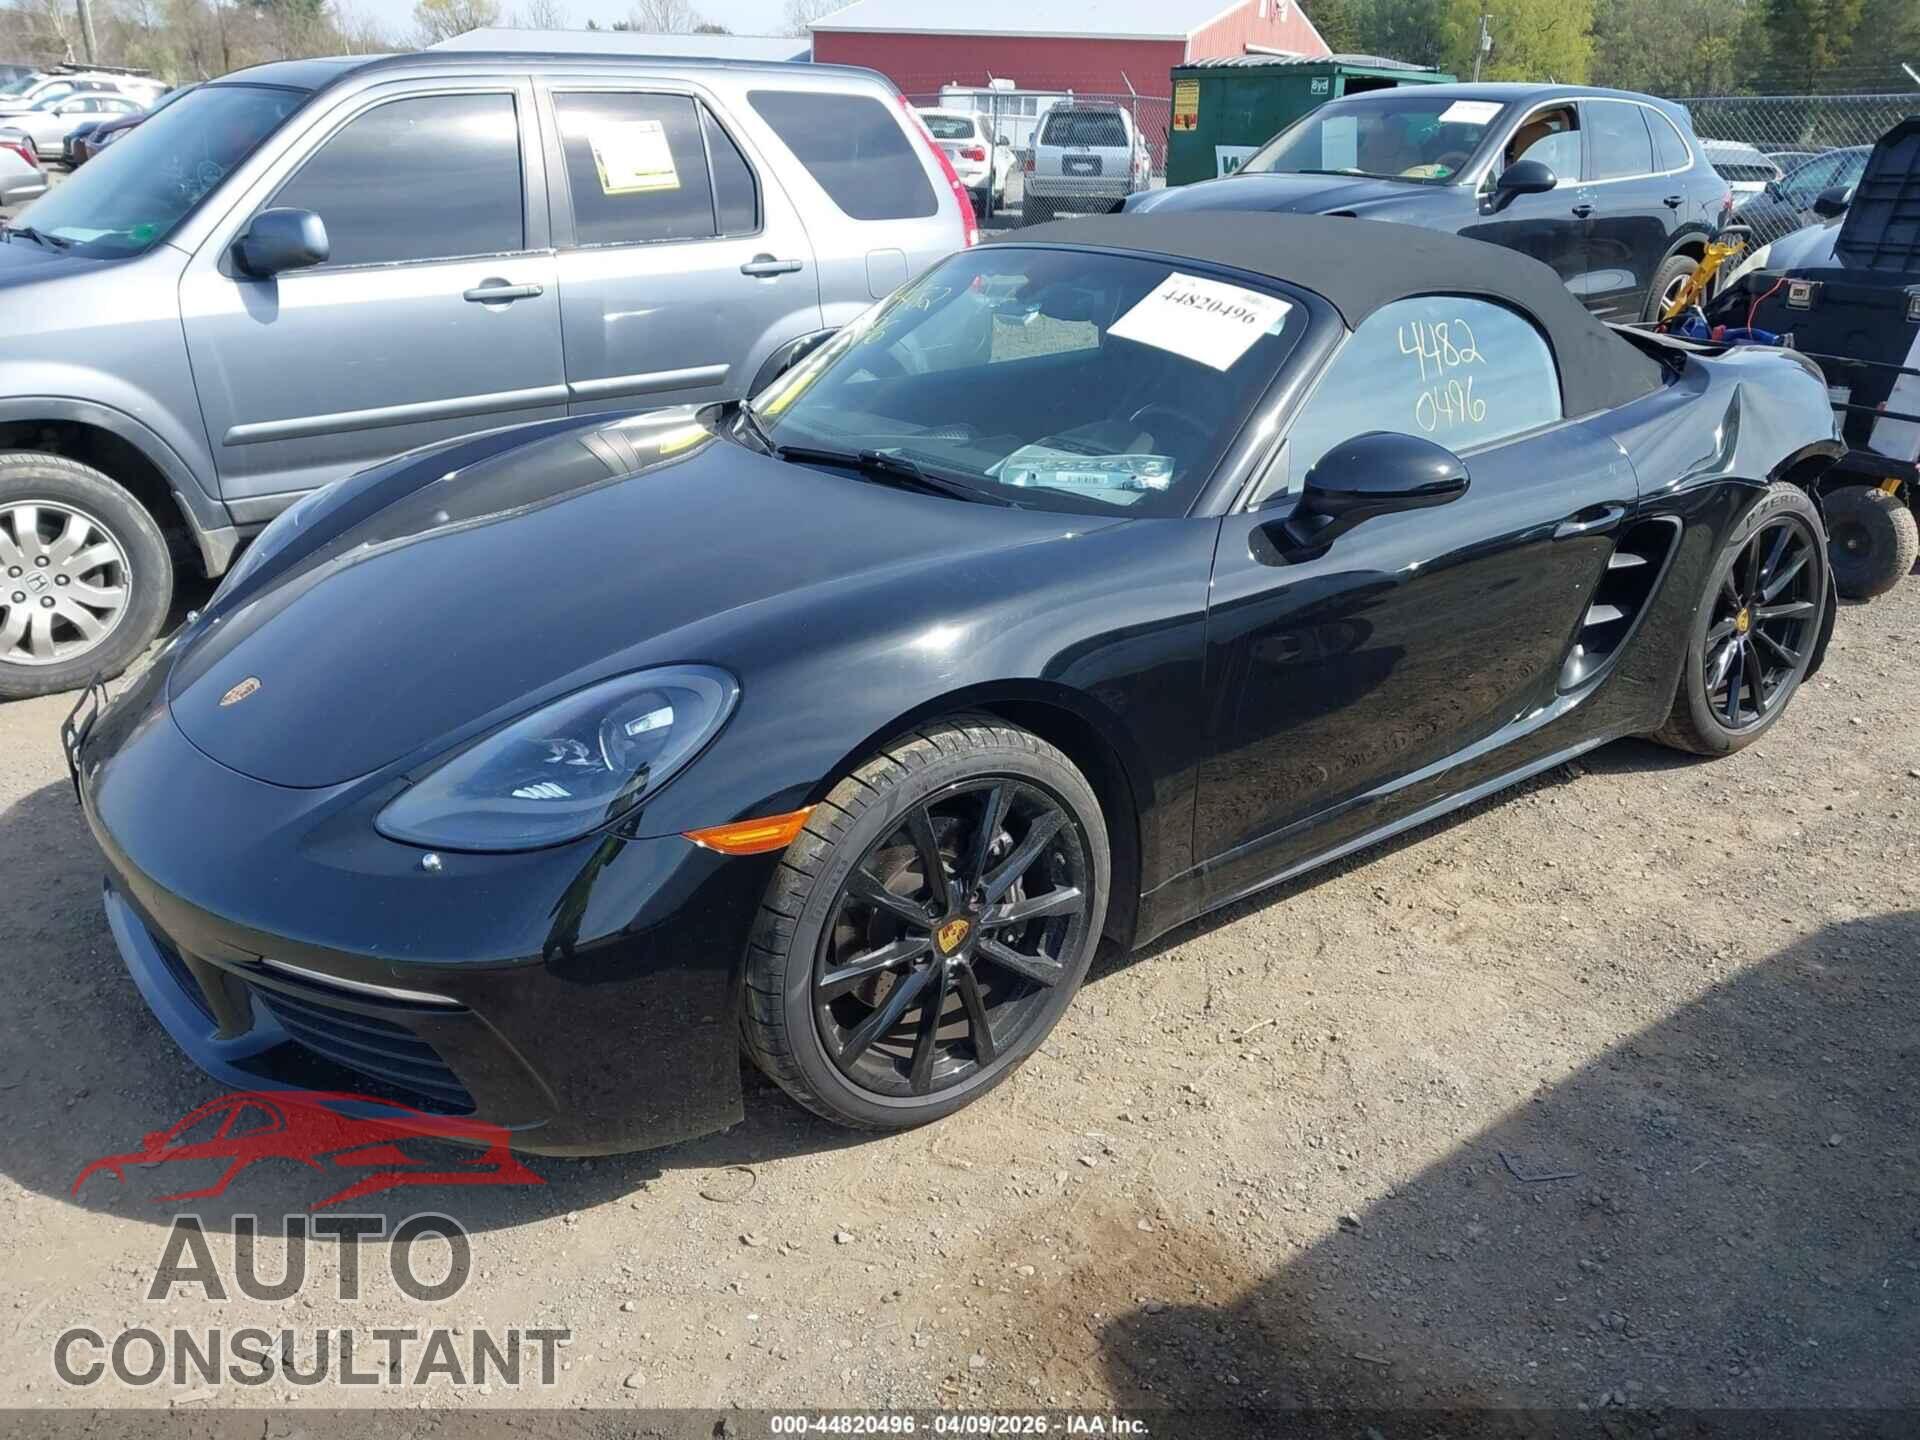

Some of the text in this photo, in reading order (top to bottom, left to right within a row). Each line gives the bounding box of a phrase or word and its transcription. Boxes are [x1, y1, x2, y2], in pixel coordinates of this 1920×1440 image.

[1162, 288, 1256, 324] 44820496
[1399, 318, 1488, 382] 4482
[1416, 375, 1486, 431] 0496
[1746, 495, 1799, 528] P ZERO
